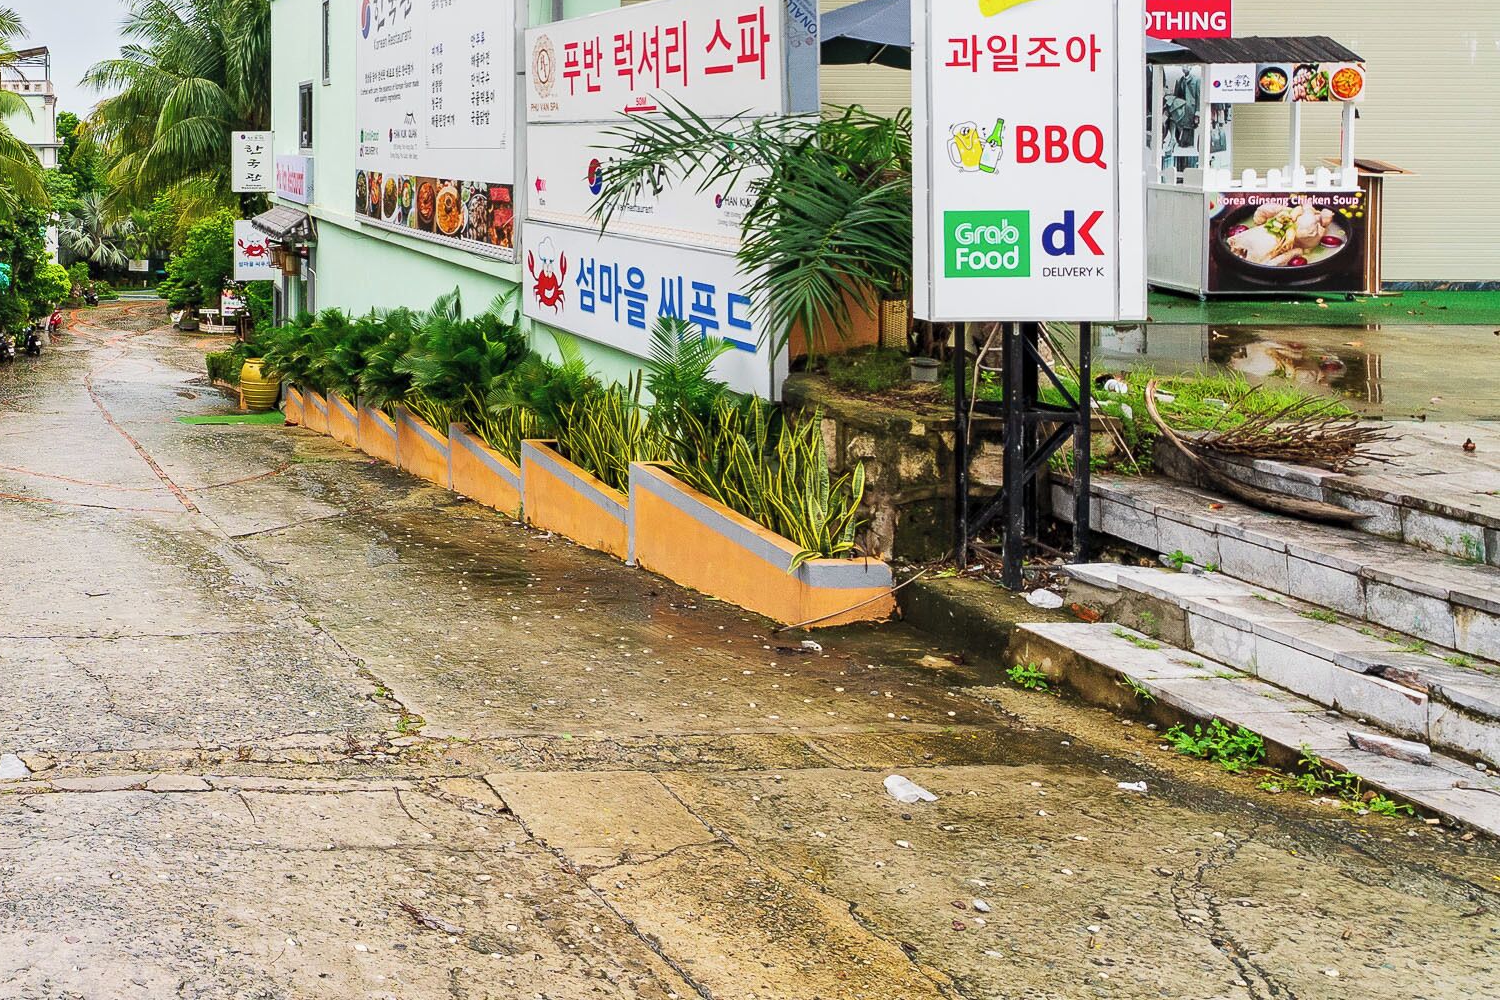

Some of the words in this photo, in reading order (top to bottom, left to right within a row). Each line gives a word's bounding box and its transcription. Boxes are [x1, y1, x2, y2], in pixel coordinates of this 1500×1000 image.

[563, 36, 602, 96] 푸반
[614, 20, 688, 91] 럭셔리
[705, 6, 770, 80] 스파
[944, 34, 1101, 73] 과일조아
[531, 103, 539, 111] PHU
[540, 103, 549, 111] VAN
[550, 102, 559, 111] SPA
[244, 144, 264, 182] 한국관
[1016, 124, 1107, 170] BBQ
[1248, 195, 1288, 207] Ginseng
[1291, 195, 1331, 205] Chicken
[1333, 195, 1359, 207] Soup
[955, 219, 1020, 245] Grab
[956, 246, 1019, 271] Food
[1043, 267, 1093, 278] DELIVERY
[1096, 266, 1105, 277] K
[576, 257, 648, 329] 섬마을
[658, 276, 757, 353] 씨푸드
